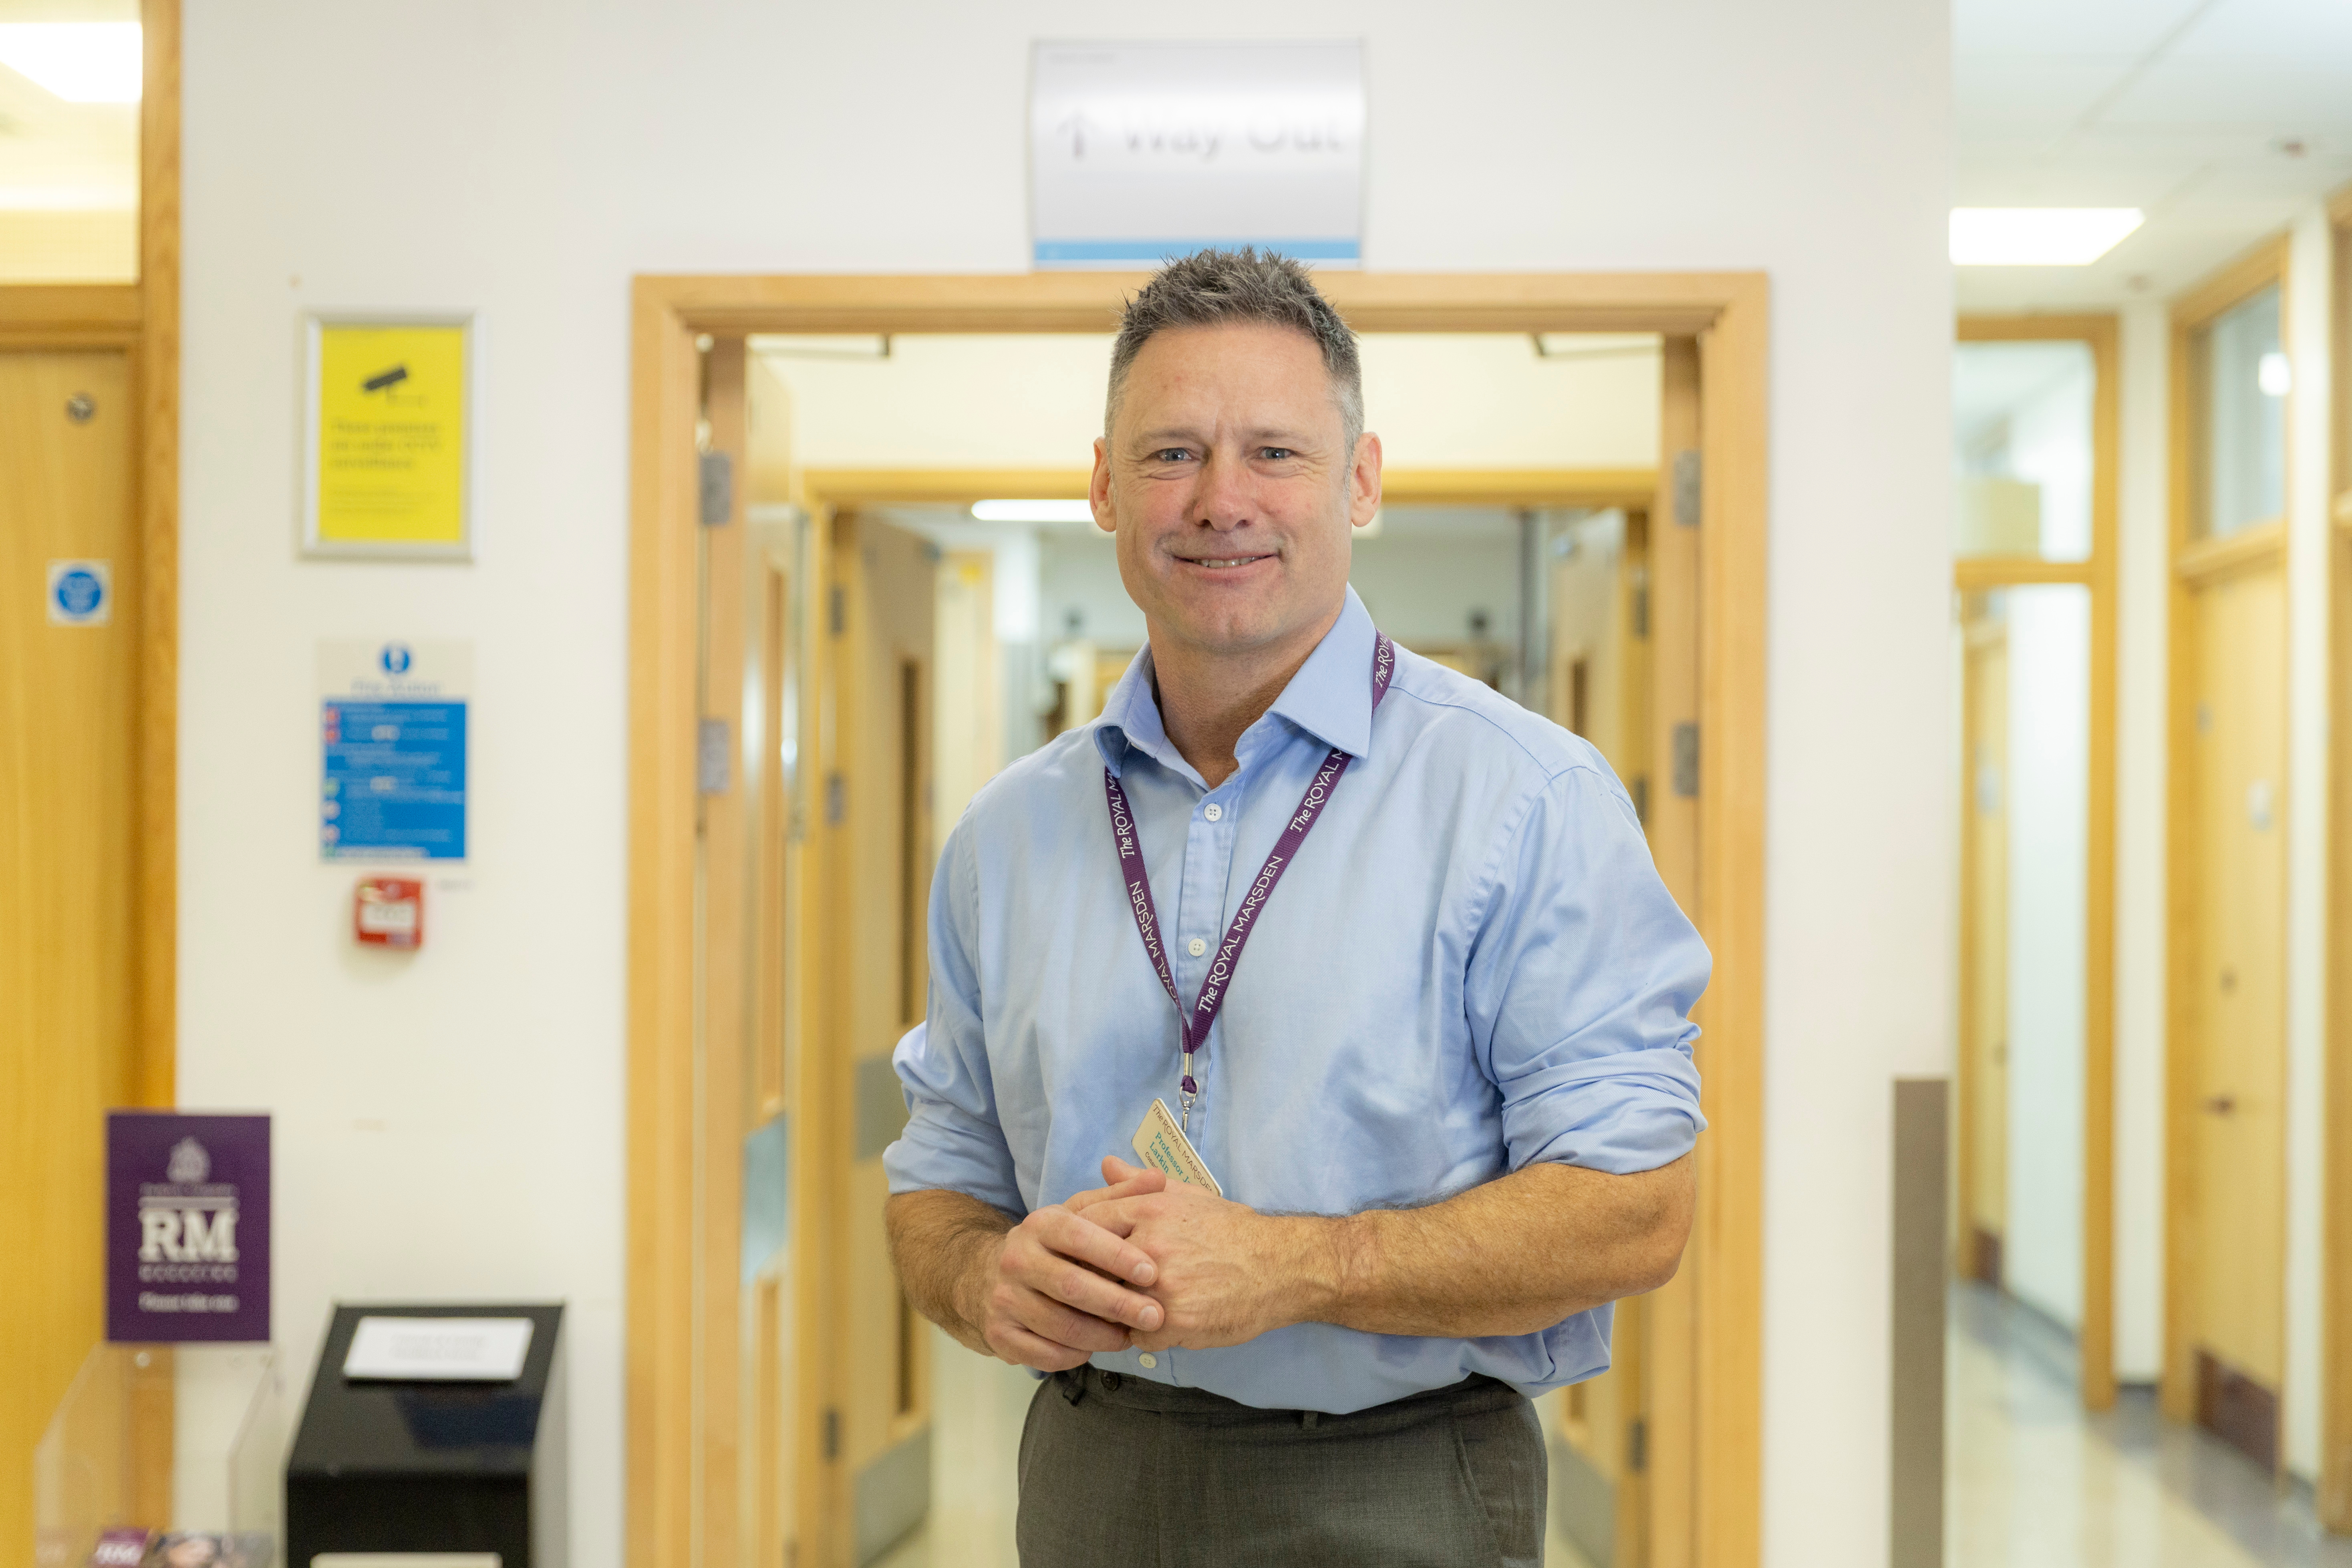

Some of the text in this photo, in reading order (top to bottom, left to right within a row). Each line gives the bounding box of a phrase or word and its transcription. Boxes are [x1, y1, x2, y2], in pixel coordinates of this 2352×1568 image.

[1123, 111, 1344, 162] Way Out
[1375, 665, 1387, 688] The
[1110, 793, 1132, 835] ROYAL
[1290, 809, 1311, 832] The
[1304, 763, 1339, 809] ROYAL
[1120, 837, 1135, 859] The
[1130, 881, 1160, 958] MARSDEN
[1198, 855, 1283, 1012] The ROYAL MARSDEN
[1150, 1141, 1169, 1174] Larkin
[1153, 1104, 1212, 1191] The ROYAL MARSDE
[1155, 1131, 1190, 1184] Professor J
[139, 1207, 239, 1263] RM
